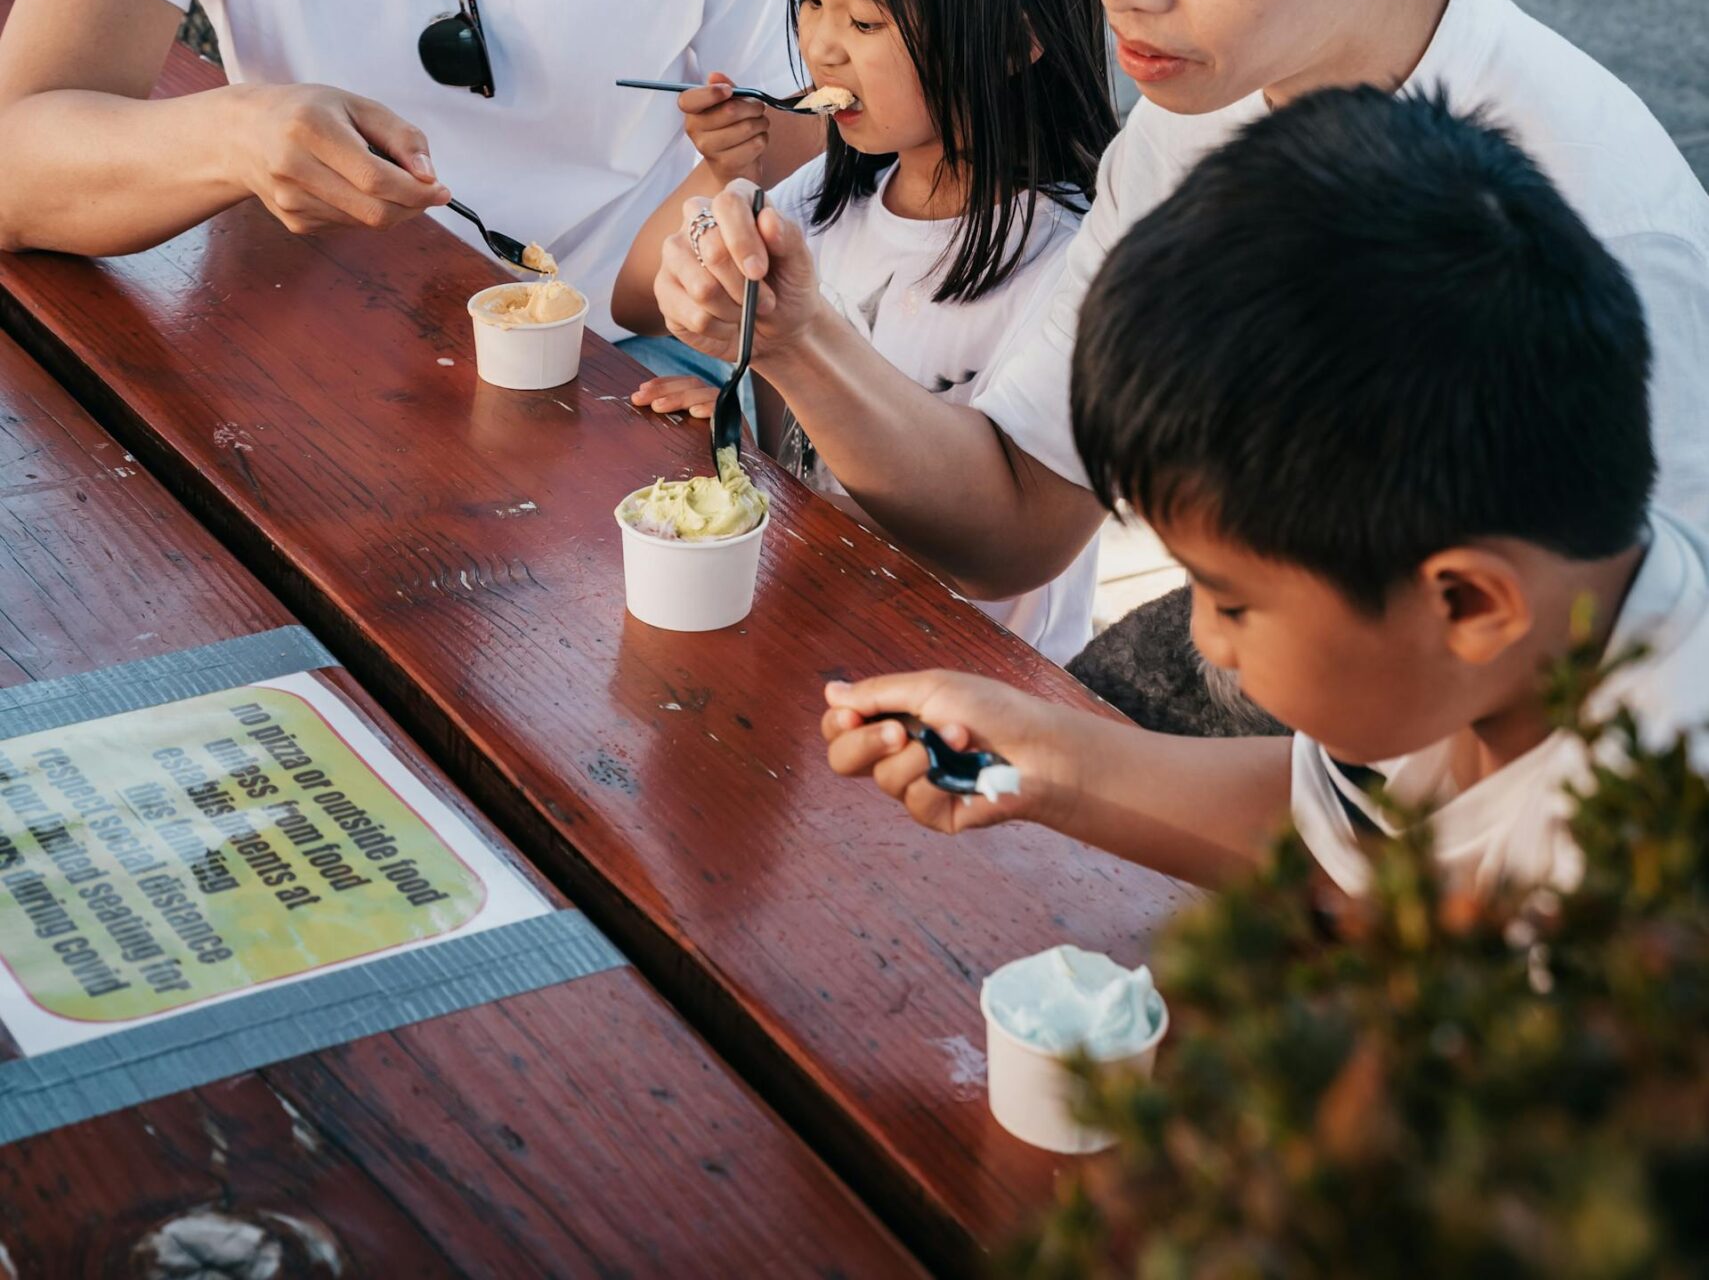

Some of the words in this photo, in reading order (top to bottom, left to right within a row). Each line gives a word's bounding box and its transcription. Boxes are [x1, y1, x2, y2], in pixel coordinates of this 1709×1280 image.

[230, 702, 271, 726] no
[247, 724, 313, 770] pizza
[152, 746, 297, 887] establishments
[275, 884, 321, 910] at
[204, 738, 279, 799] unless
[263, 799, 325, 846] from
[302, 843, 373, 892] food
[292, 768, 334, 790] or
[313, 791, 398, 861] outside
[1, 783, 49, 814] our
[25, 812, 110, 885] limited
[78, 882, 165, 962] seating
[138, 957, 192, 994] for
[32, 747, 117, 818] respect
[89, 815, 168, 877] social
[136, 873, 233, 964] distance
[123, 781, 177, 821] this
[154, 818, 241, 894] landing
[378, 858, 450, 907] food
[1, 869, 79, 939] during
[52, 936, 132, 998] covid
